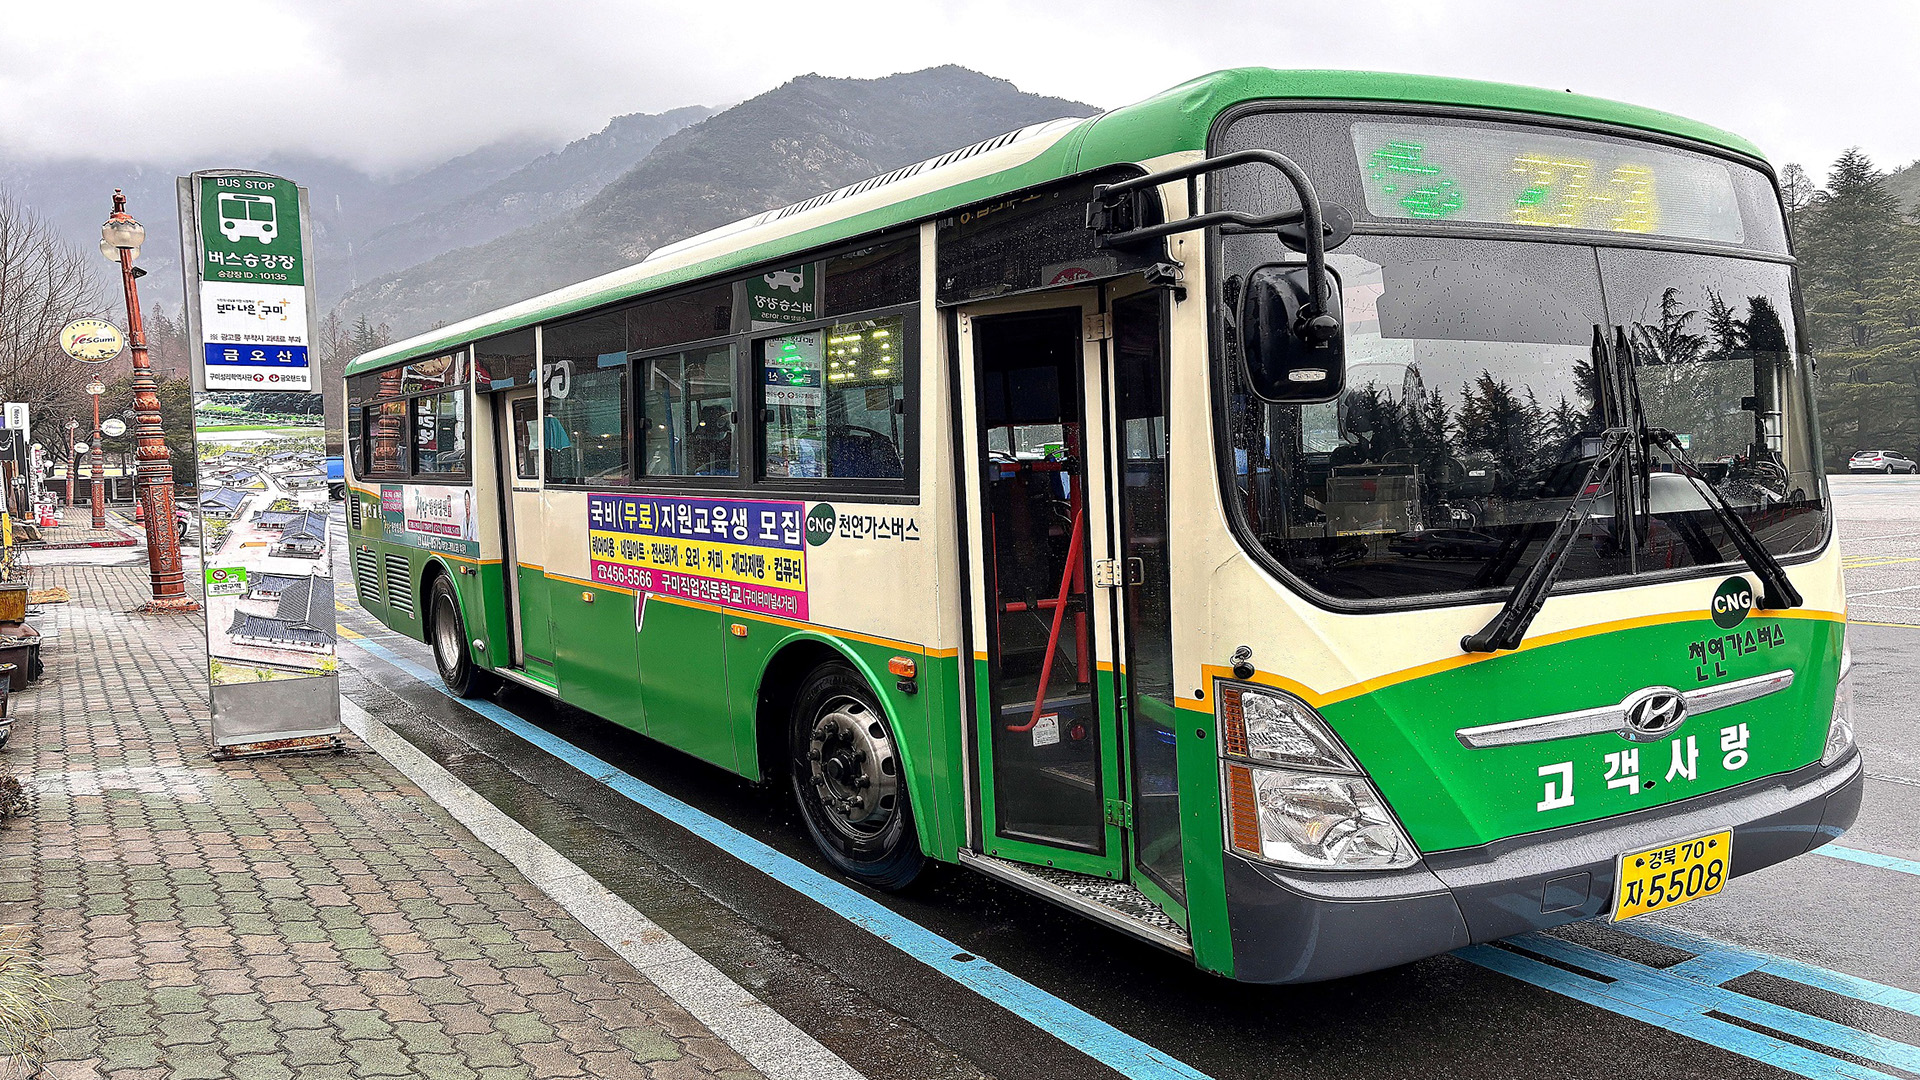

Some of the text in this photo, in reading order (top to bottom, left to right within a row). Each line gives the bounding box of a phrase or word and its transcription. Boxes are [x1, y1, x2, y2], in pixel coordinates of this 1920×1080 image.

[217, 178, 275, 190] BUS STOP
[208, 251, 295, 270] 버스승강장
[217, 270, 242, 279] 승강장
[243, 271, 253, 279] ID
[259, 272, 287, 281] 10135
[217, 303, 283, 315] 보다 나은 구미
[758, 510, 801, 545] 모집
[806, 516, 833, 533] CNG
[839, 514, 920, 541] 천연가스버스
[651, 543, 679, 567] 전산회계
[685, 547, 700, 570] 요리
[707, 549, 724, 573] 커피
[731, 552, 765, 579] 제과제빵
[774, 557, 802, 584] 컴퓨터
[607, 565, 653, 588] 456-5566
[1714, 591, 1751, 614] CNG
[1688, 623, 1785, 682] 천연가스버스
[1649, 840, 1705, 870] 경북 70
